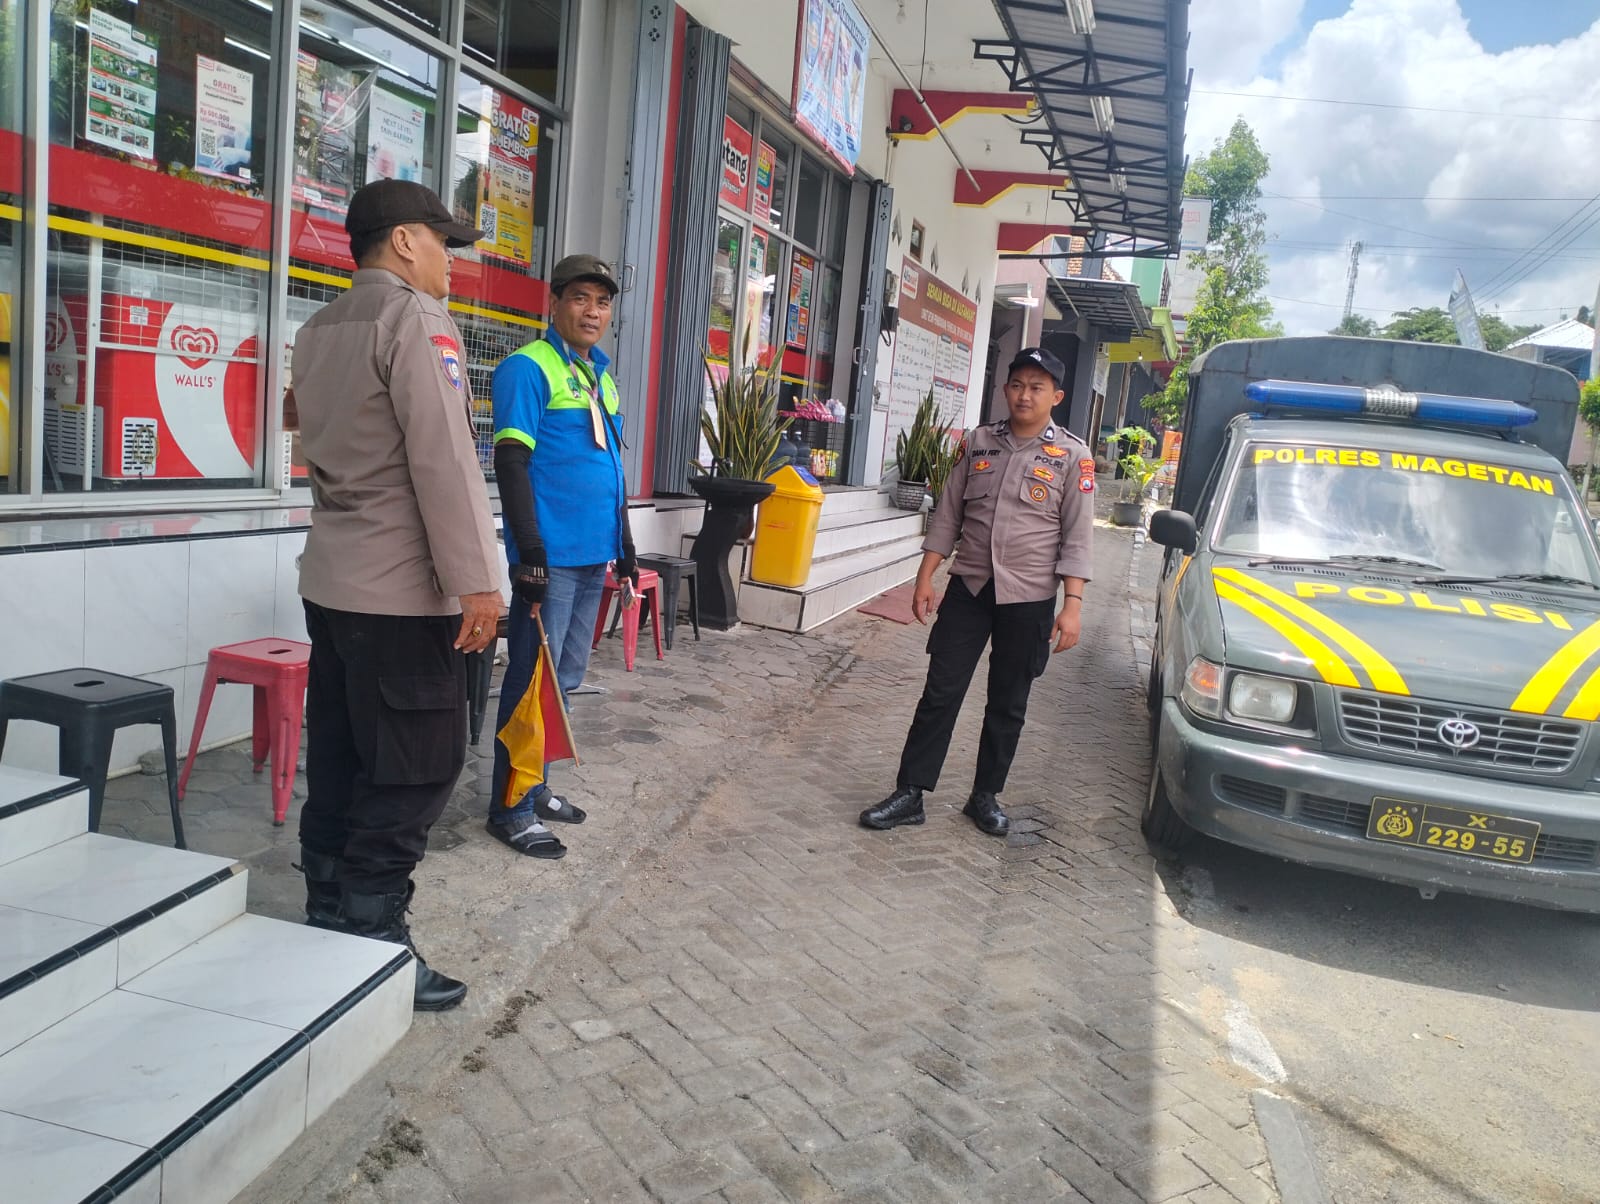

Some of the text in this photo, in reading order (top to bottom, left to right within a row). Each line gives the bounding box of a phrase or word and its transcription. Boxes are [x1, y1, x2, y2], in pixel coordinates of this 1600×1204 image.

[213, 79, 237, 93] GRATIS
[491, 109, 530, 141] GRATIS
[174, 373, 214, 388] WALL'S
[1034, 456, 1064, 469] POLRI
[1253, 448, 1555, 496] POLRES MAGETAN
[1294, 581, 1573, 631] POLISI
[1467, 814, 1488, 829] X
